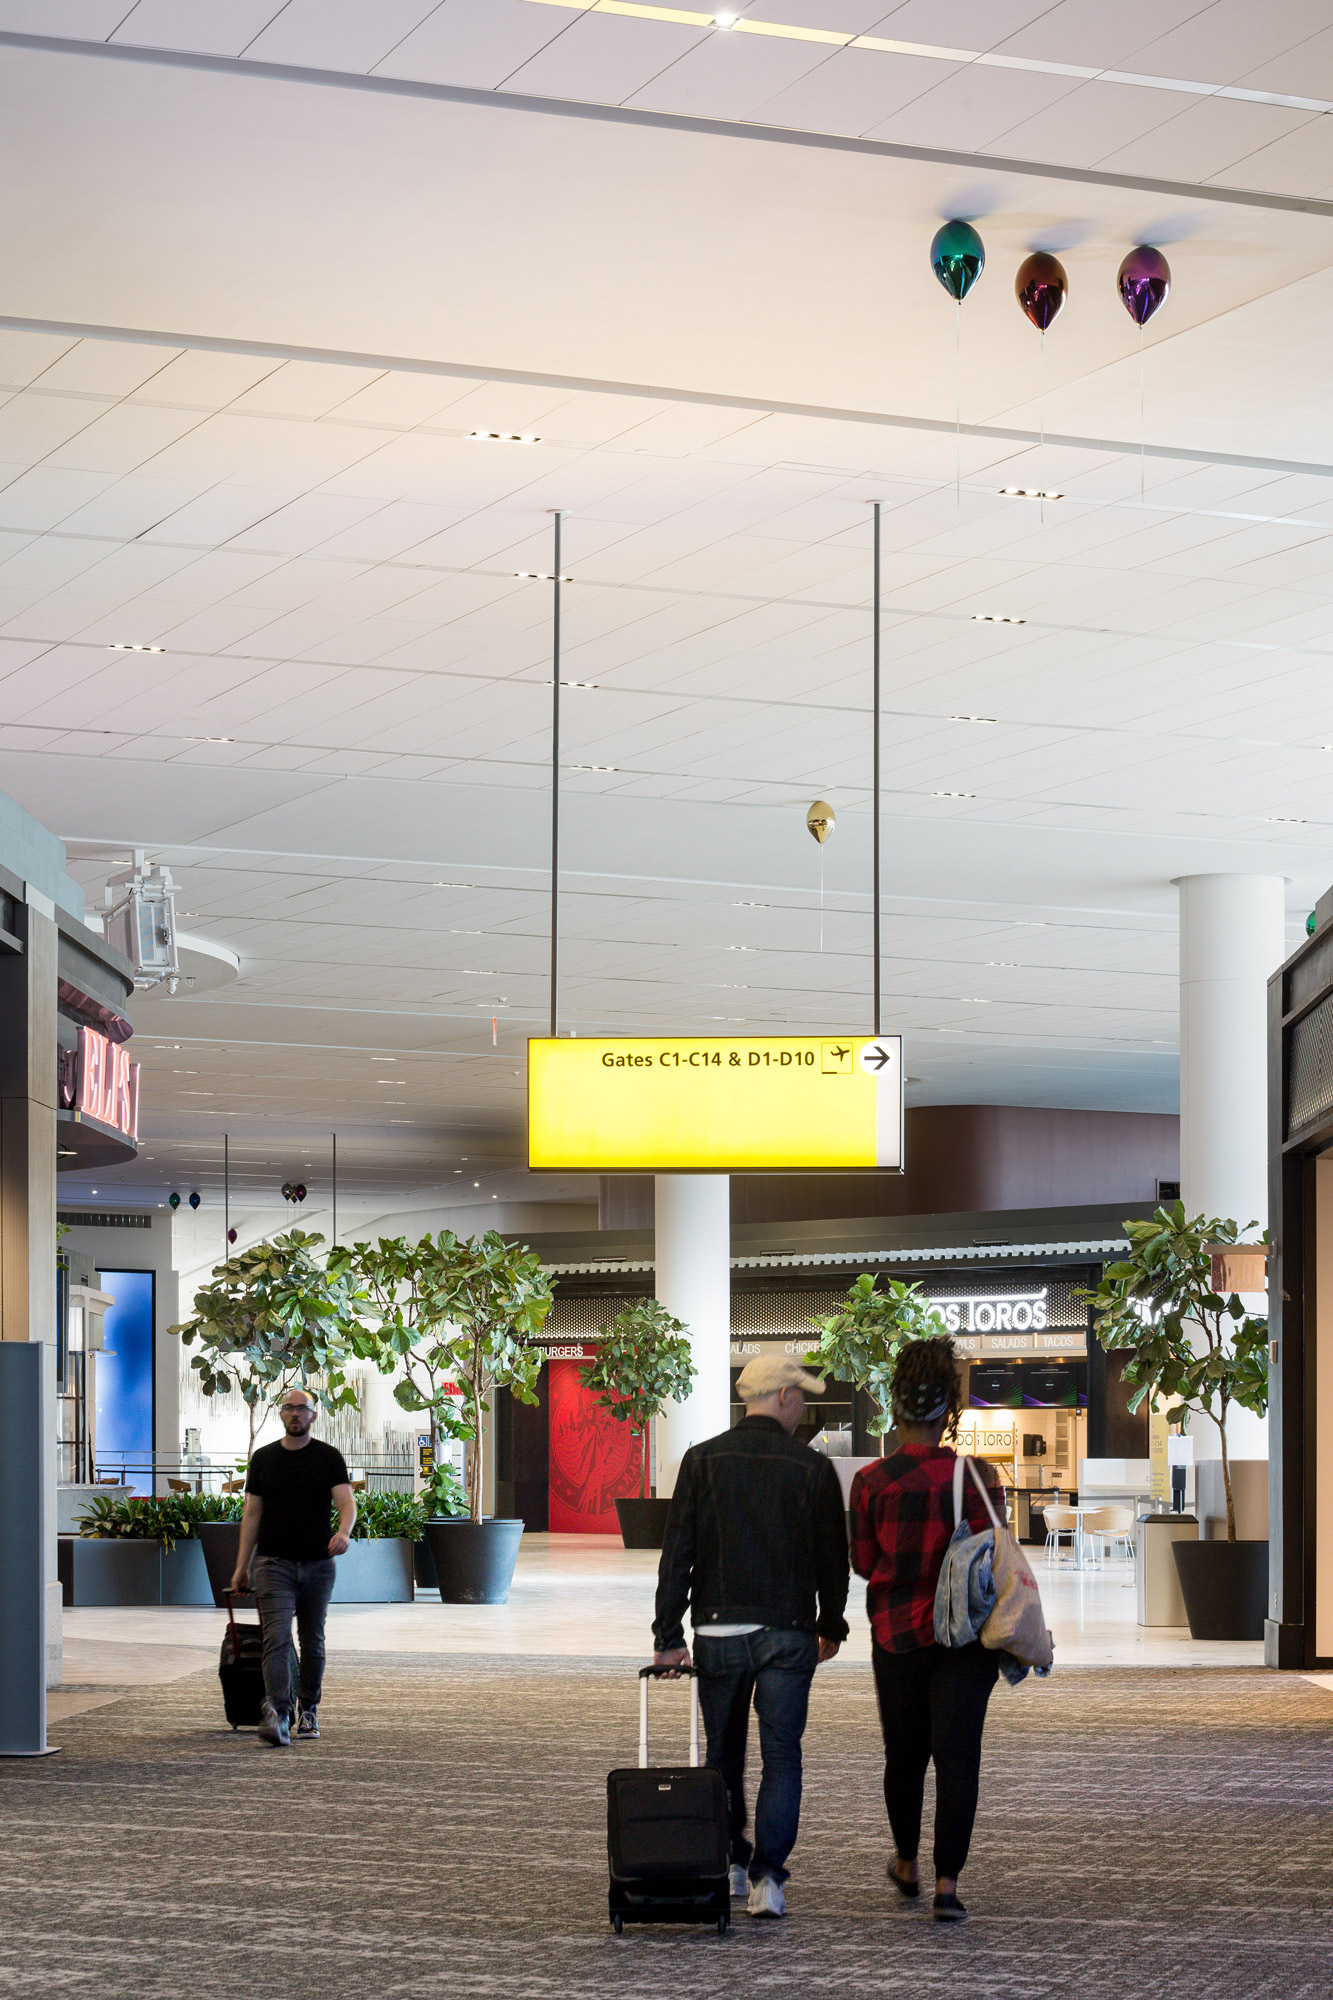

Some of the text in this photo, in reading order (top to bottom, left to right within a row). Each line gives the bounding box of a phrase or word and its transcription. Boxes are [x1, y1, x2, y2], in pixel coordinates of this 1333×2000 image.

[602, 1051, 815, 1067] Gates C1-C14 & D1-D10
[991, 1337, 1028, 1349] SALADS
[1042, 1335, 1074, 1348] TACOS
[730, 1344, 761, 1354] ALADS
